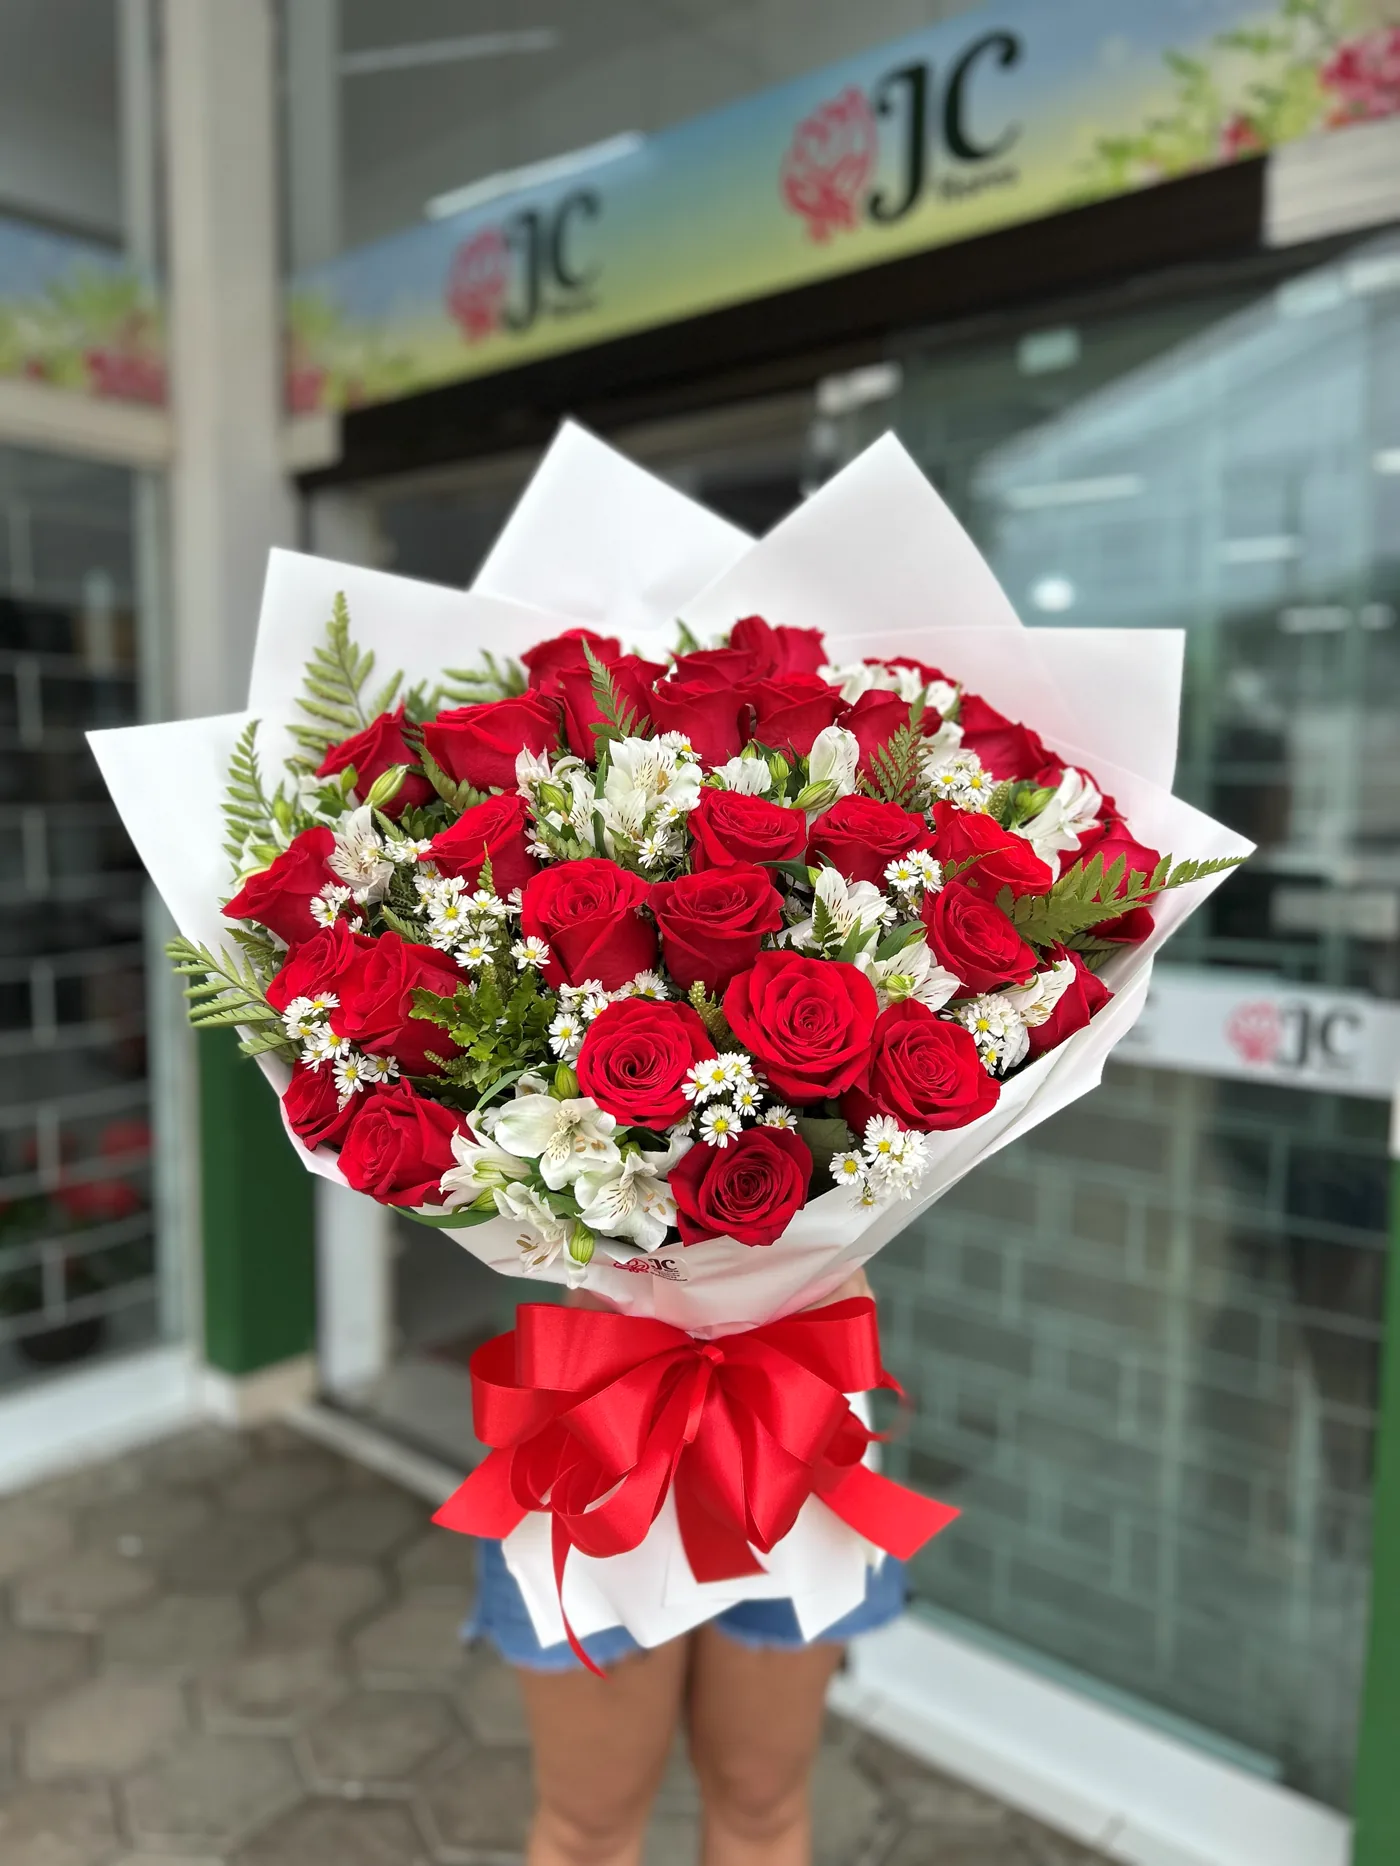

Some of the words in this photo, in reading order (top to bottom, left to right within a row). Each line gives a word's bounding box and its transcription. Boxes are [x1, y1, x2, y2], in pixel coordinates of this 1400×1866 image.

[869, 30, 1022, 223] JC
[503, 188, 600, 332] JC
[1276, 1001, 1362, 1068] JC
[648, 1258, 677, 1271] JC
